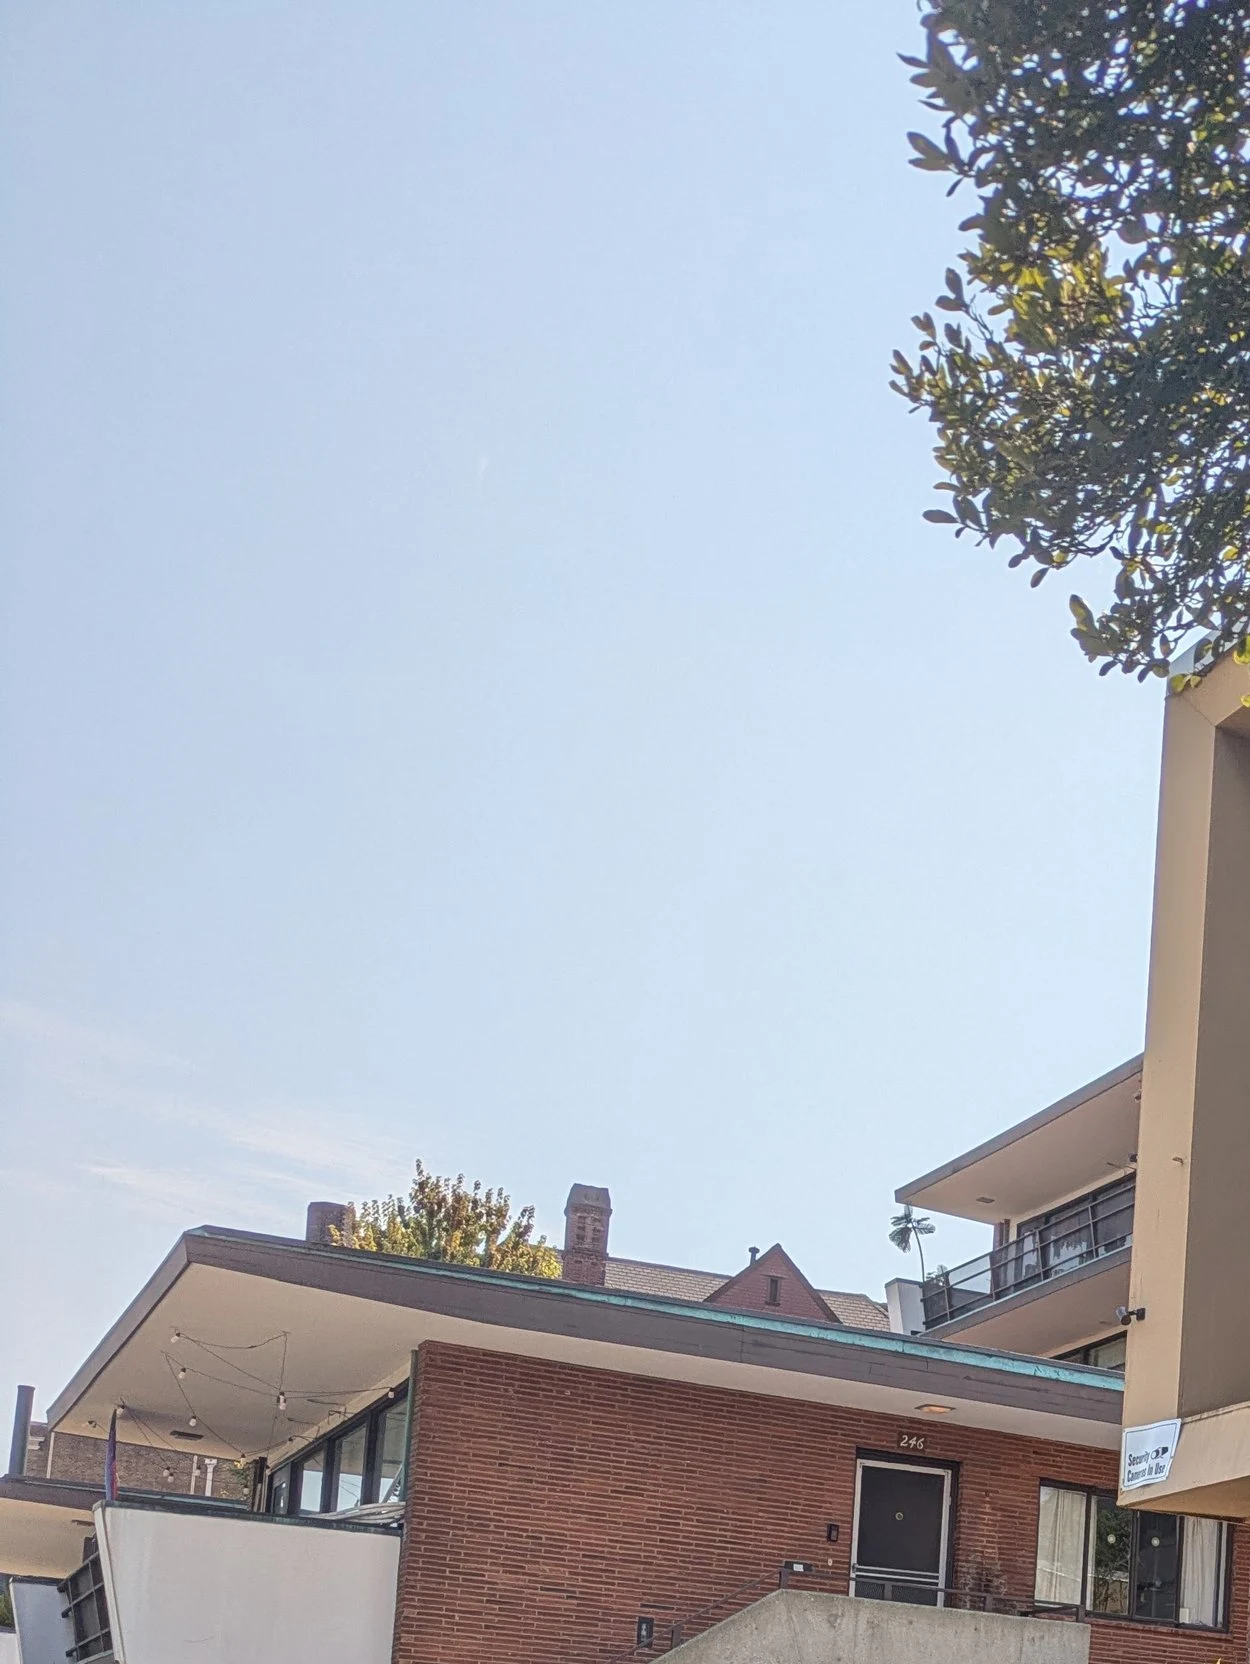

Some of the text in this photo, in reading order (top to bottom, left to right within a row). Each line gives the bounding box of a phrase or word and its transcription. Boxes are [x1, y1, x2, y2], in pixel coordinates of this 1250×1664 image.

[900, 1435, 925, 1450] 246
[1128, 1451, 1149, 1466] Security
[1127, 1462, 1166, 1482] Cameras In Use
